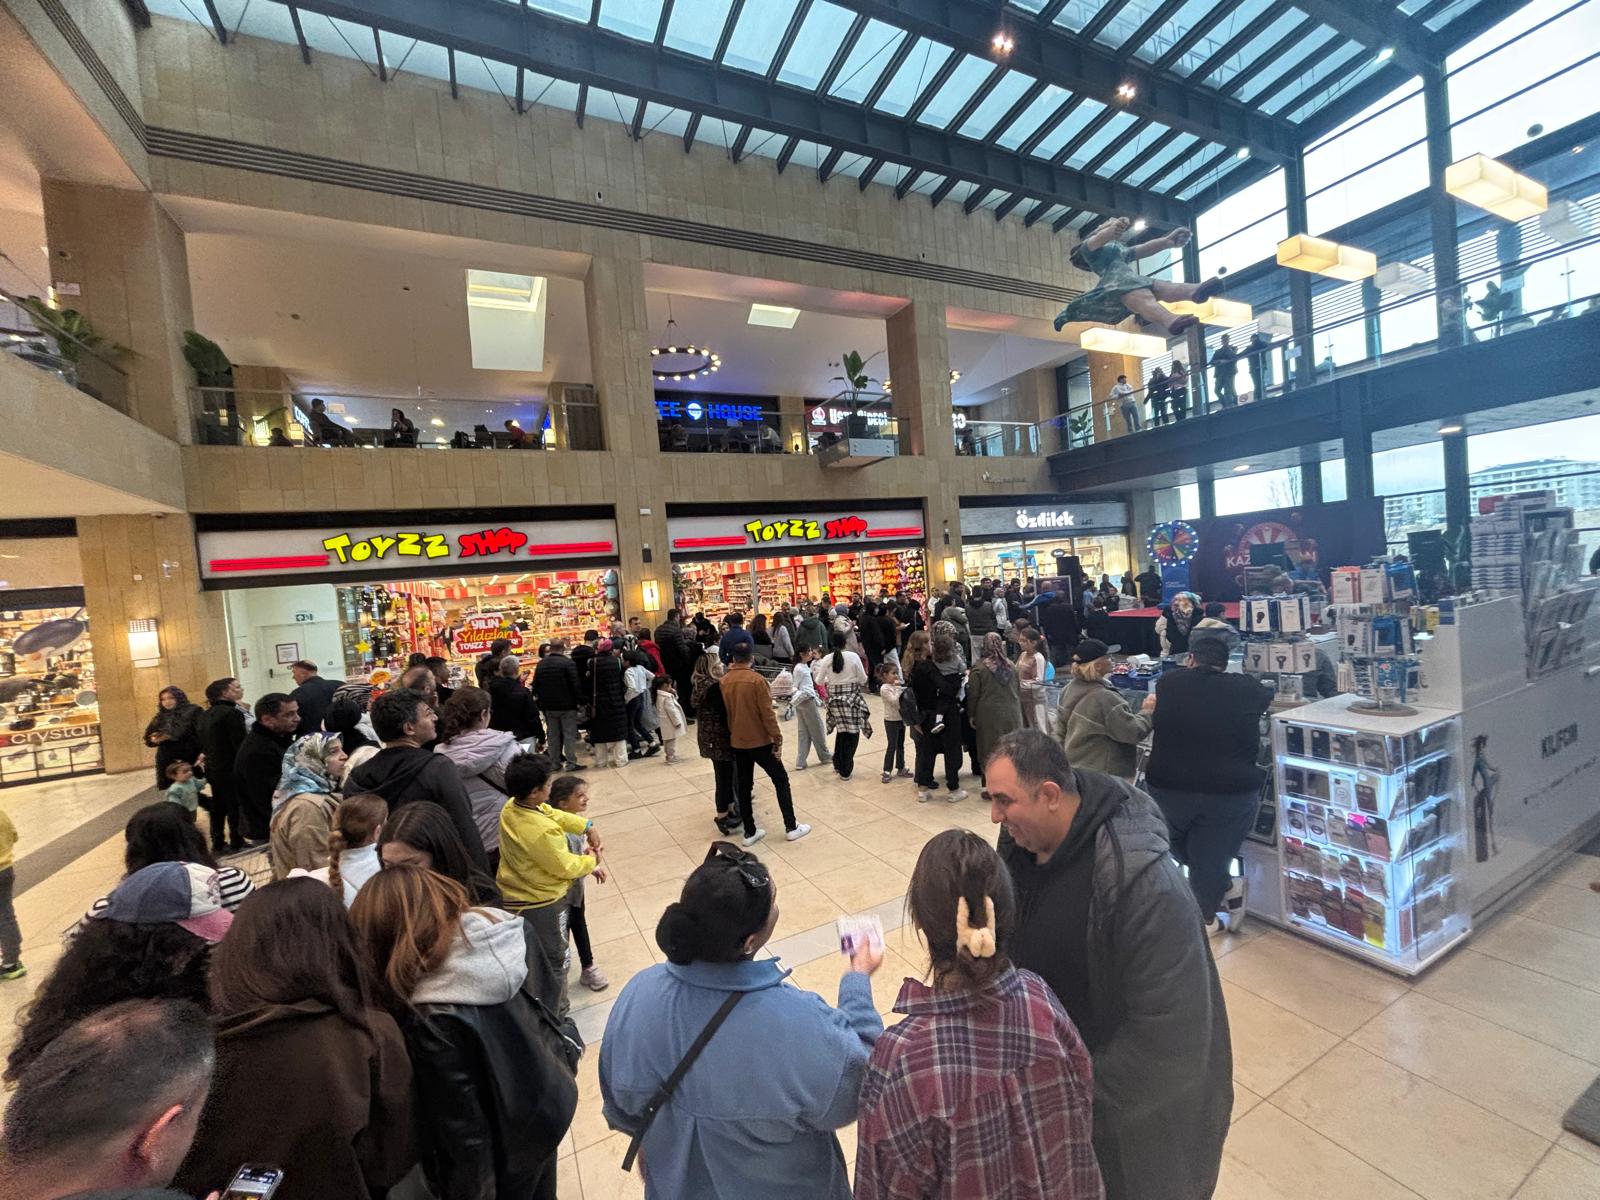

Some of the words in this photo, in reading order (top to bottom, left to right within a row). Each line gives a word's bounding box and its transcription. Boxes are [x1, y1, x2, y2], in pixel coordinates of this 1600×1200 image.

[707, 403, 763, 420] HOUSE
[824, 516, 867, 539] SHOP
[1016, 509, 1075, 528] Özdilek
[458, 527, 528, 558] SHOP
[11, 725, 91, 744] crystal
